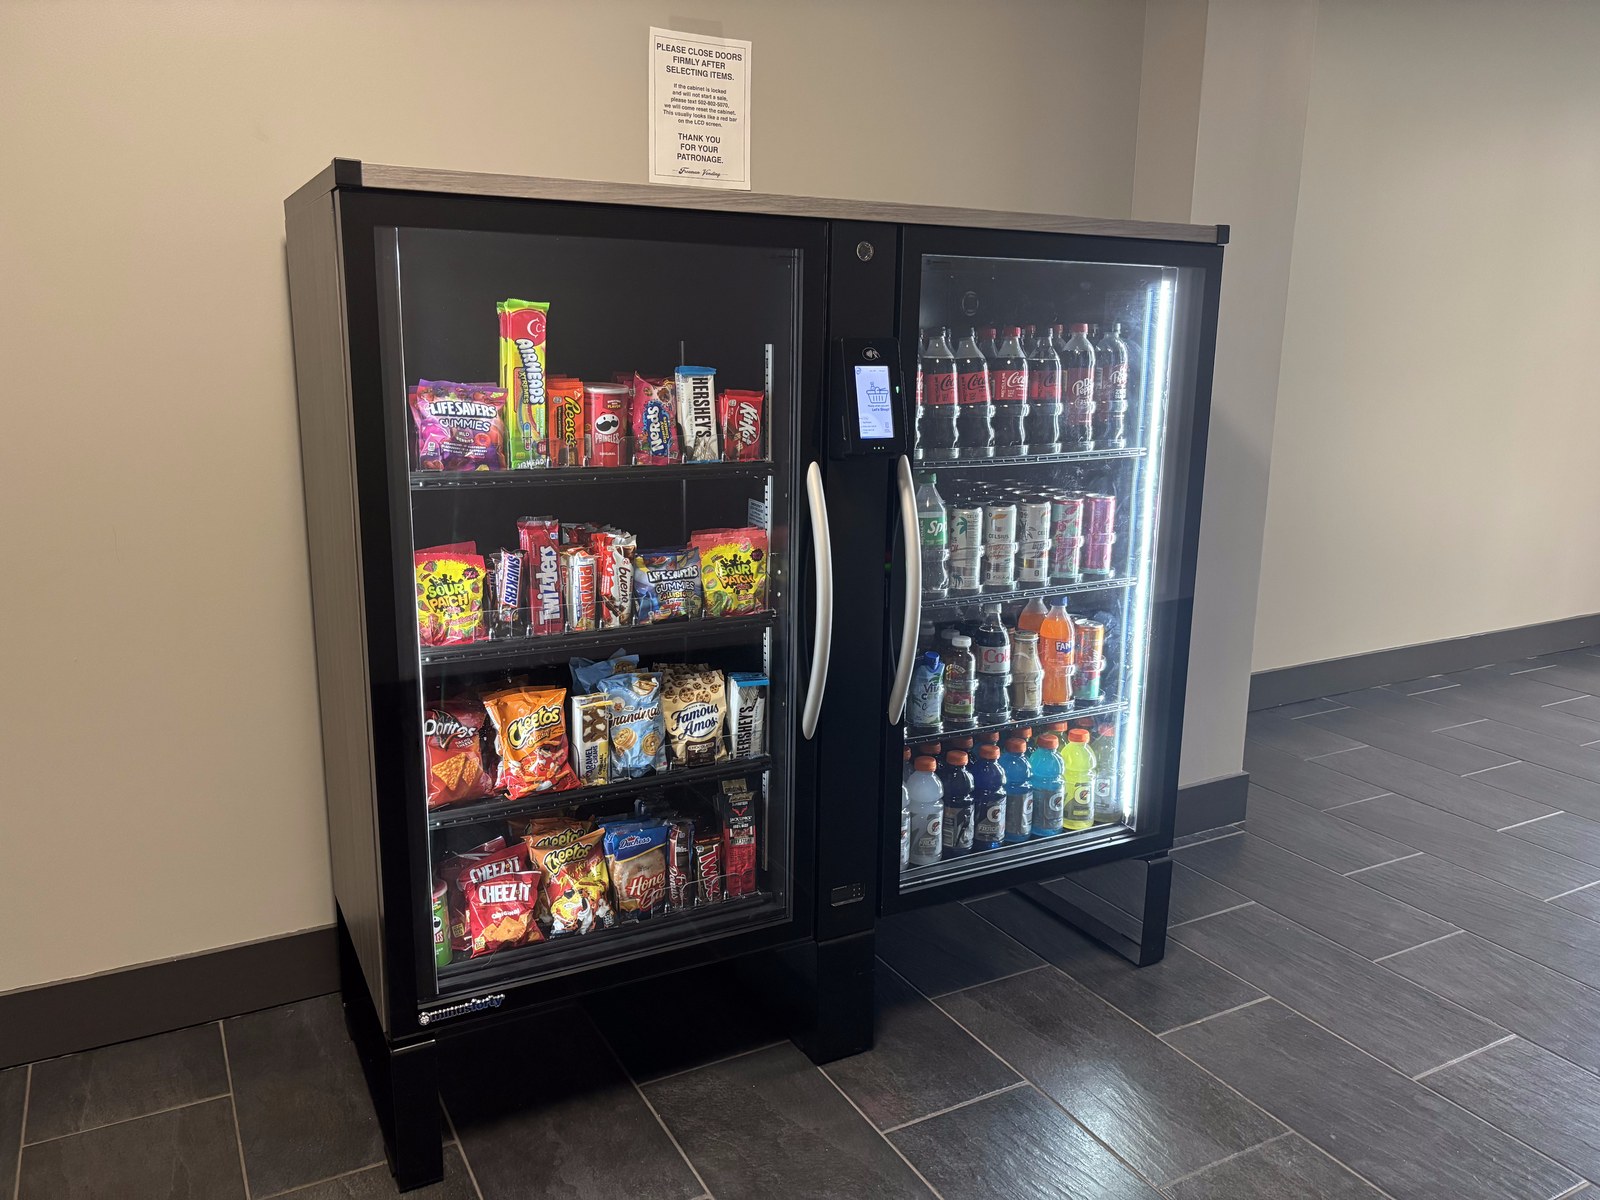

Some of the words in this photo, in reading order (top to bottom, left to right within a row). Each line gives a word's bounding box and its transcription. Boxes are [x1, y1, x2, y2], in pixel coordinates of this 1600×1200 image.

[656, 42, 686, 54] PLEASE
[688, 48, 713, 58] CLOSE
[715, 51, 742, 62] DOORS
[672, 56, 700, 66] FIRMLY
[702, 60, 726, 70] AFTER
[666, 65, 708, 78] SELECTING
[710, 72, 734, 80] ITEMS.
[678, 132, 704, 142] THANK
[706, 136, 720, 144] YOU
[680, 143, 696, 151] FOR
[698, 144, 718, 153] YOUR
[676, 153, 724, 164] PATRONAGE.
[515, 338, 545, 404] AIRHEADS
[692, 377, 712, 438] HERSHEY'S
[440, 418, 492, 432] GUMMIES
[594, 432, 620, 444] PRINGLES
[722, 564, 751, 575] SOUR
[504, 552, 520, 606] SNICKERS
[619, 566, 630, 603] bueno
[722, 574, 756, 588] PATCH
[428, 583, 464, 598] SOUR
[656, 581, 695, 594] GUMMIES
[428, 593, 470, 611] PATCH
[671, 704, 719, 731] Famous
[424, 718, 476, 738] Doritos
[508, 706, 562, 750] Cheetos
[678, 718, 718, 740] Amos
[736, 706, 754, 759] HERSHEY'S
[618, 837, 652, 849] Duchess
[543, 842, 592, 876] Cheetos
